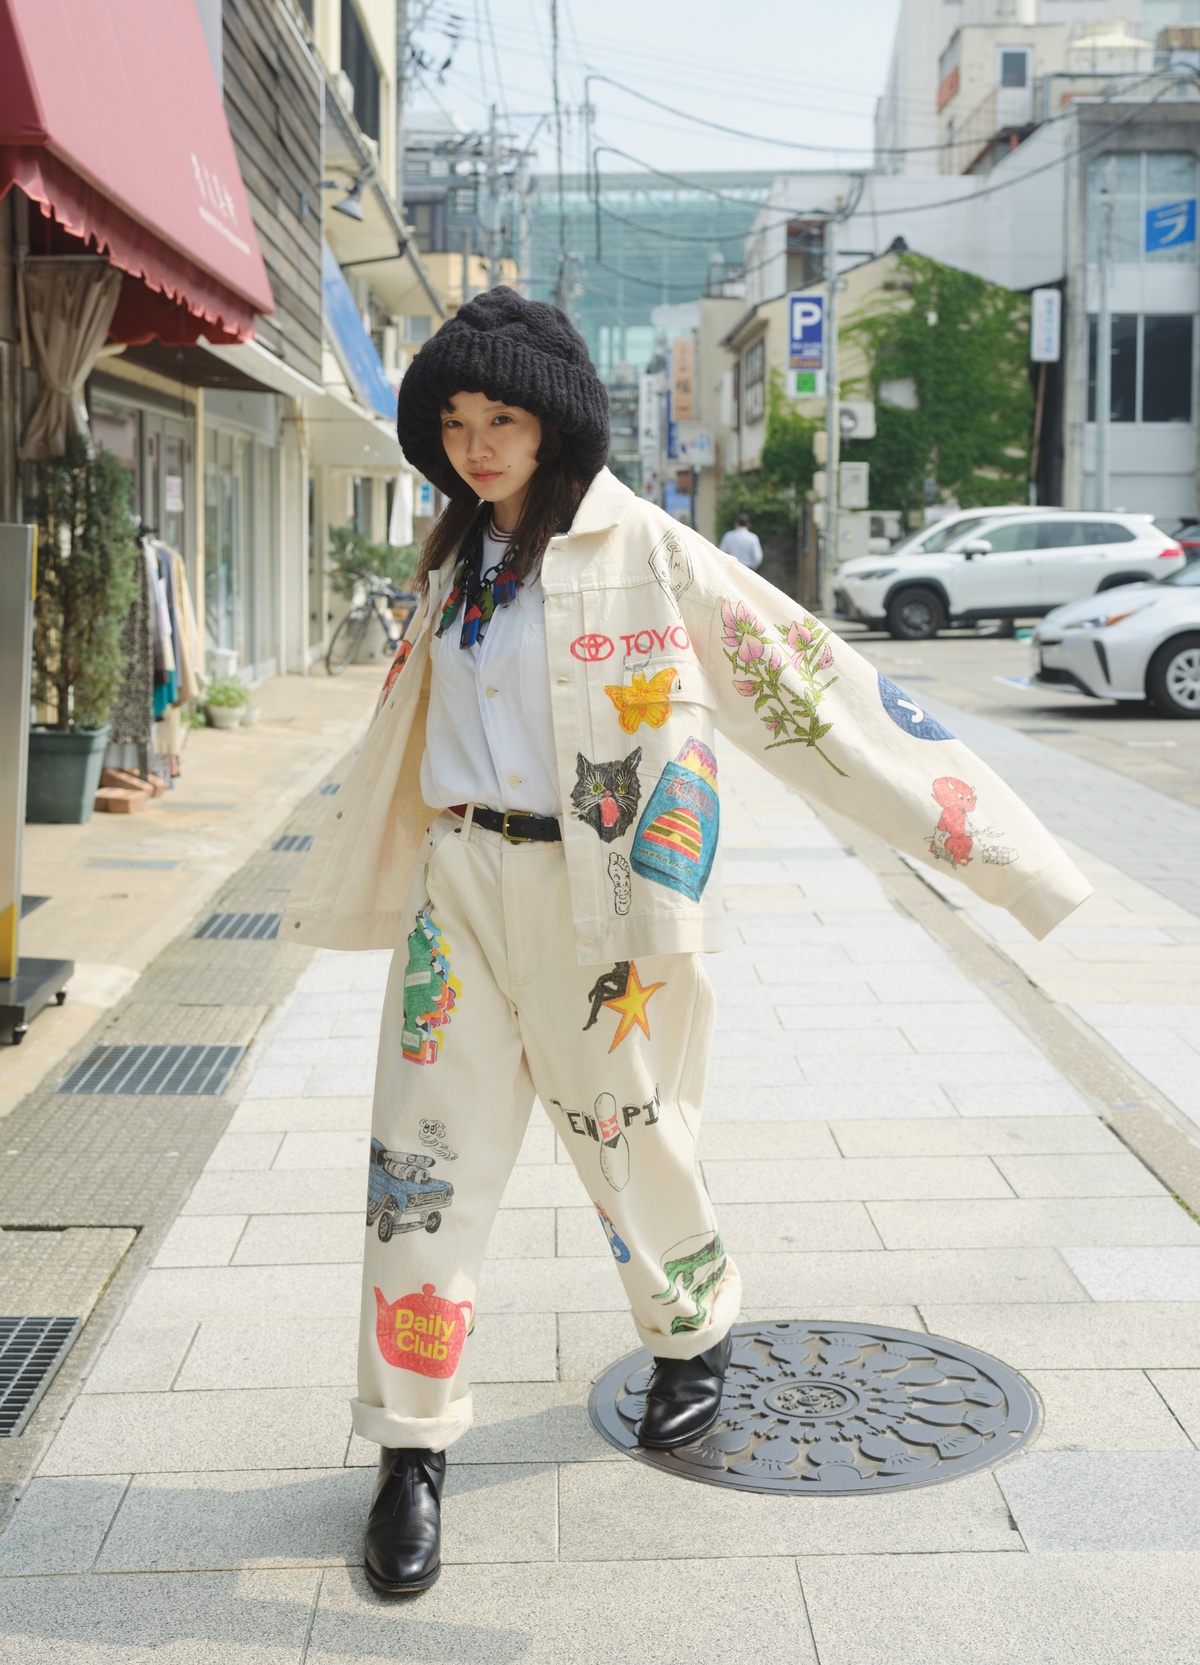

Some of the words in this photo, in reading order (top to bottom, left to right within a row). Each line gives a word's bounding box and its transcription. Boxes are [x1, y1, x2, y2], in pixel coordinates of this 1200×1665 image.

[792, 301, 822, 341] P
[619, 625, 690, 657] TOYO
[395, 1308, 456, 1342] Daily
[396, 1330, 449, 1361] Club
